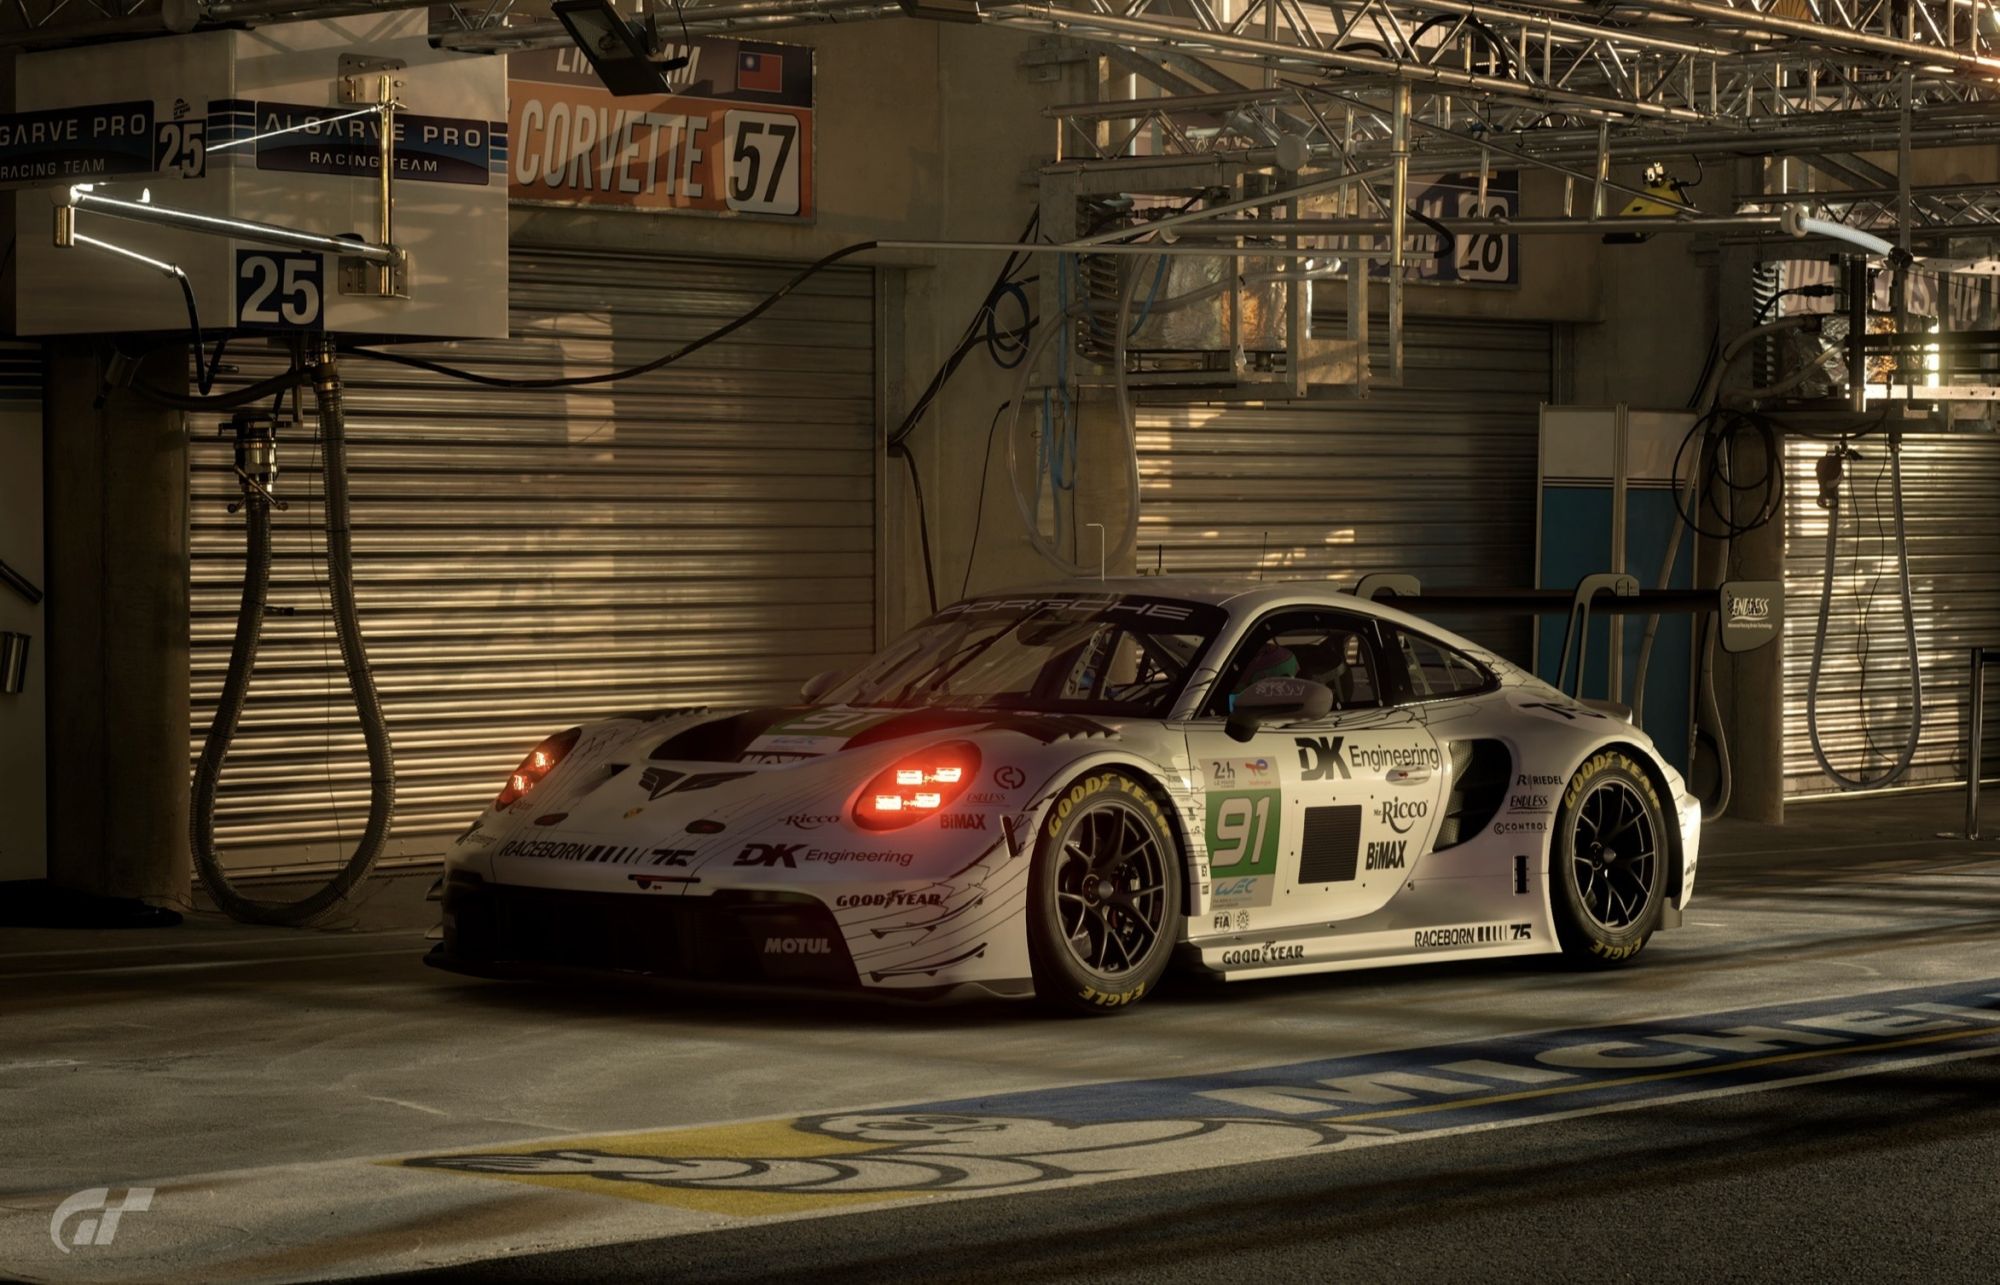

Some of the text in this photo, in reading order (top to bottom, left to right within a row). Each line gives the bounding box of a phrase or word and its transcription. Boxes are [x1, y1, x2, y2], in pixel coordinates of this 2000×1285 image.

[93, 113, 146, 138] PRO
[265, 113, 481, 147] ALGARVE PRO
[159, 122, 203, 178] 25
[515, 99, 708, 198] CORVETTE
[1, 158, 105, 179] RACING TEAM
[310, 151, 438, 172] RACING EAM
[732, 121, 796, 203] 57
[240, 256, 320, 325] 25
[935, 599, 1194, 621] PORSCHE
[1295, 736, 1440, 781] DK Engineering
[1532, 775, 1564, 784] RIEDEL
[1511, 796, 1548, 807] ENDLESS
[1211, 797, 1270, 868] 91
[1505, 822, 1548, 831] CONTROL
[498, 840, 589, 862] RACEBORN
[732, 843, 914, 868] DK Engineering
[1365, 840, 1407, 870] BiMAX
[763, 936, 831, 955] MOTUL
[1415, 924, 1532, 947] RACEBORN 75
[1221, 941, 1305, 965] GOODYEAR
